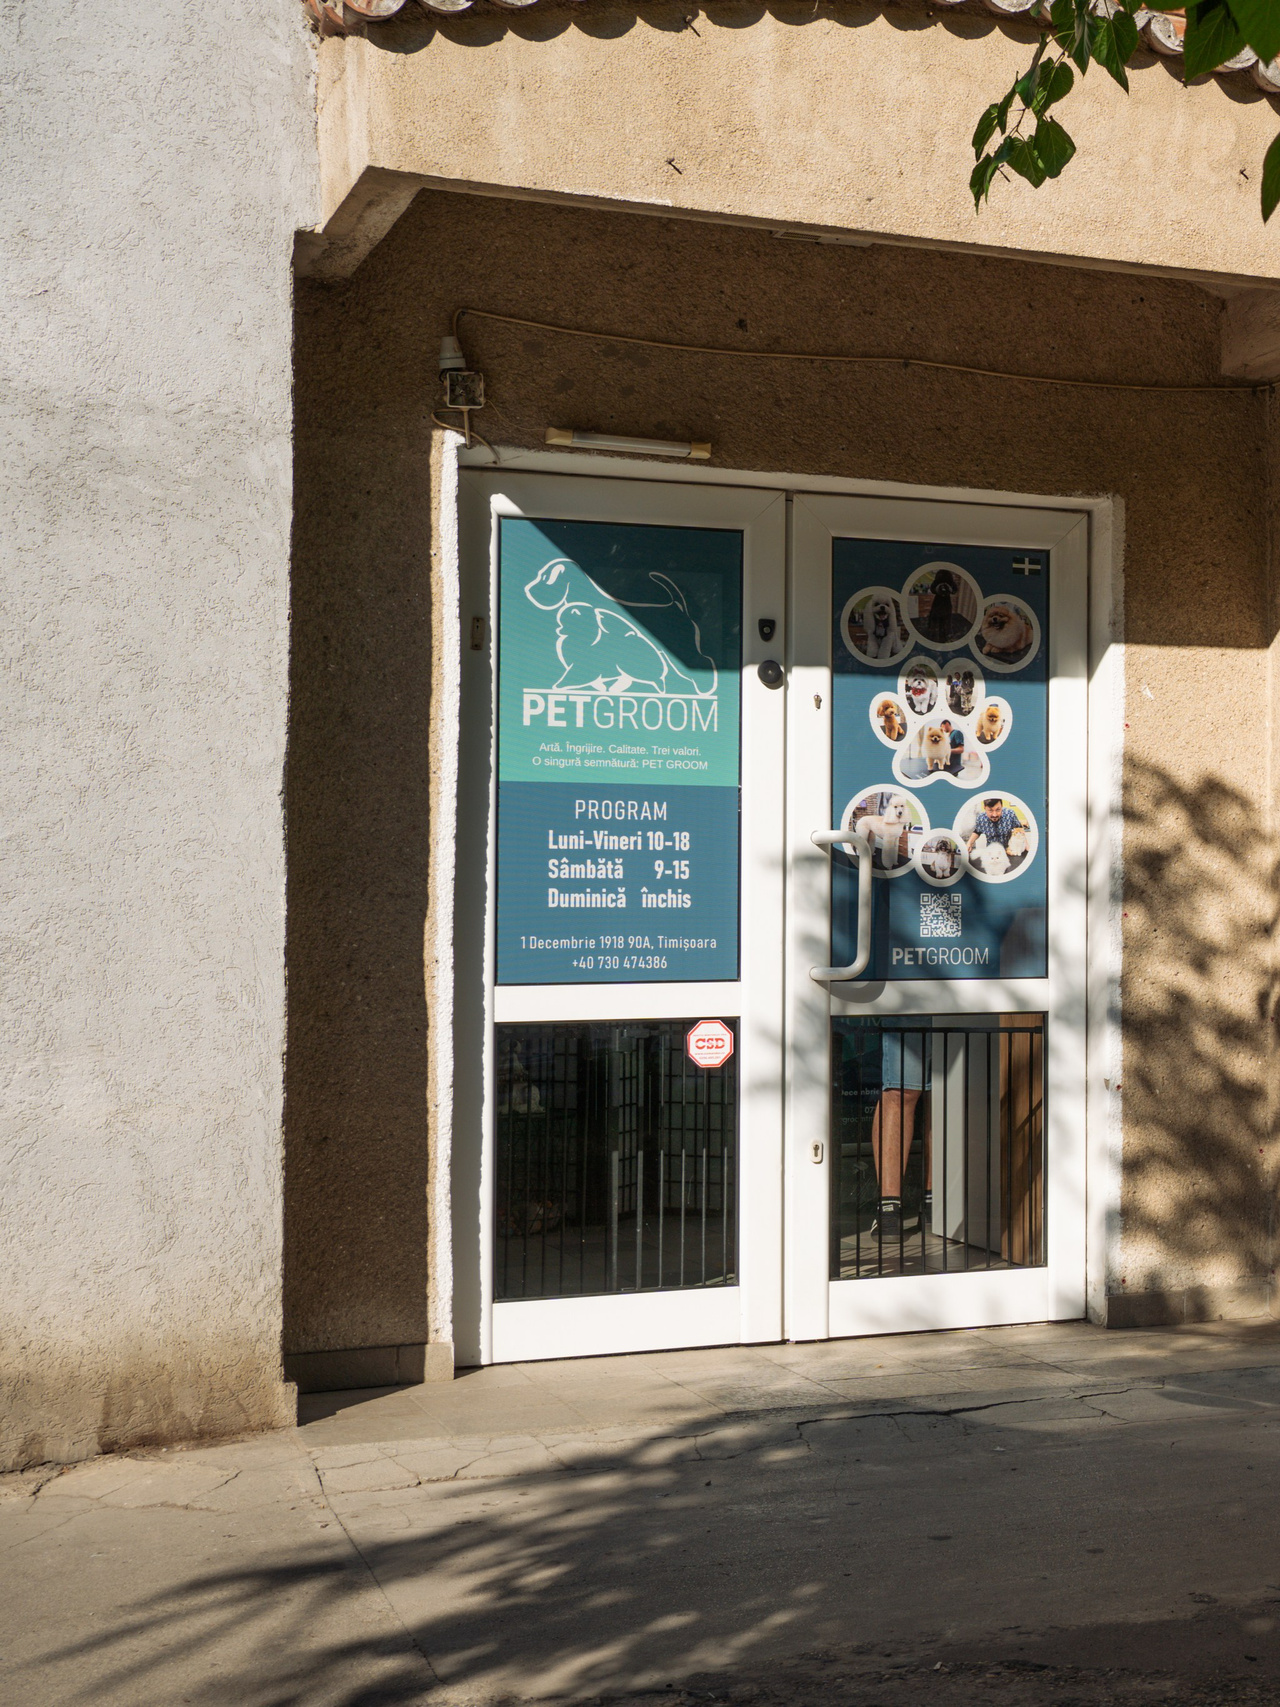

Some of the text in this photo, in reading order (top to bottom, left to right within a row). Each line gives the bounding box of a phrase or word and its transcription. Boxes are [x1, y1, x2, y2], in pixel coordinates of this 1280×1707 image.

[522, 694, 718, 732] PETGROOM
[539, 741, 702, 757] Artă. Îngrijire. Calitate. Trei valori.
[532, 756, 708, 770] O singură semnătură: PET GROOM
[575, 799, 668, 821] PROGRAM
[548, 829, 690, 851] Luni-Vineri 10-18
[548, 857, 690, 880] Sâmbătă 9-15
[548, 886, 692, 908] Duminică închis
[520, 936, 717, 951] 1 Decembrie 1918 90A, Timișoara
[572, 956, 668, 969] +40 730 474386
[891, 947, 990, 966] PETGROOM
[695, 1037, 725, 1050] CSD
